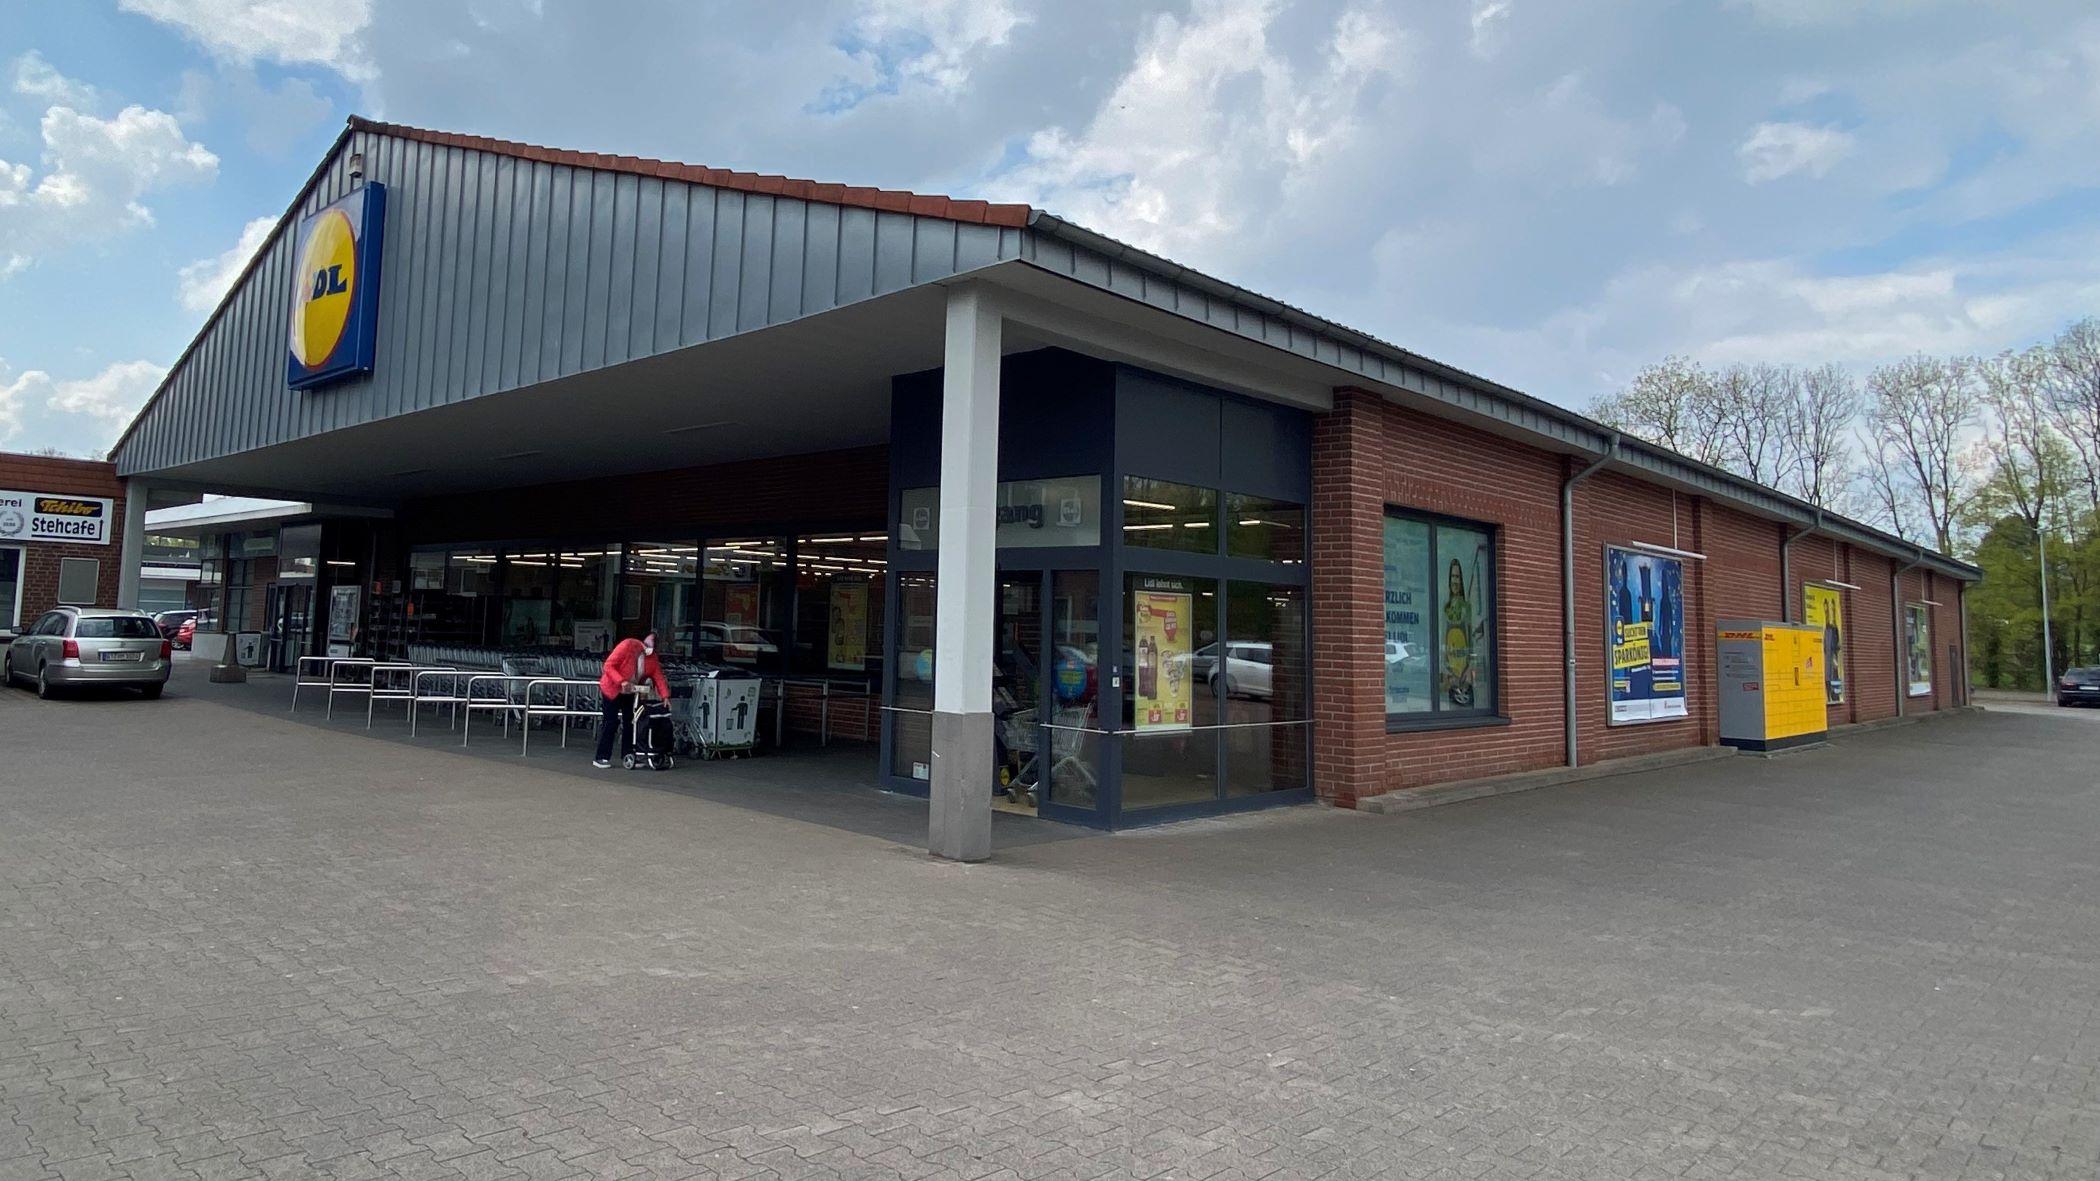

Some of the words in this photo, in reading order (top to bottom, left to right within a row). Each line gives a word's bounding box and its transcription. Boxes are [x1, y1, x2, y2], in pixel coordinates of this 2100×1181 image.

[39, 499, 100, 515] Tchibo
[997, 504, 1044, 529] ang
[32, 517, 96, 536] Stehcafe
